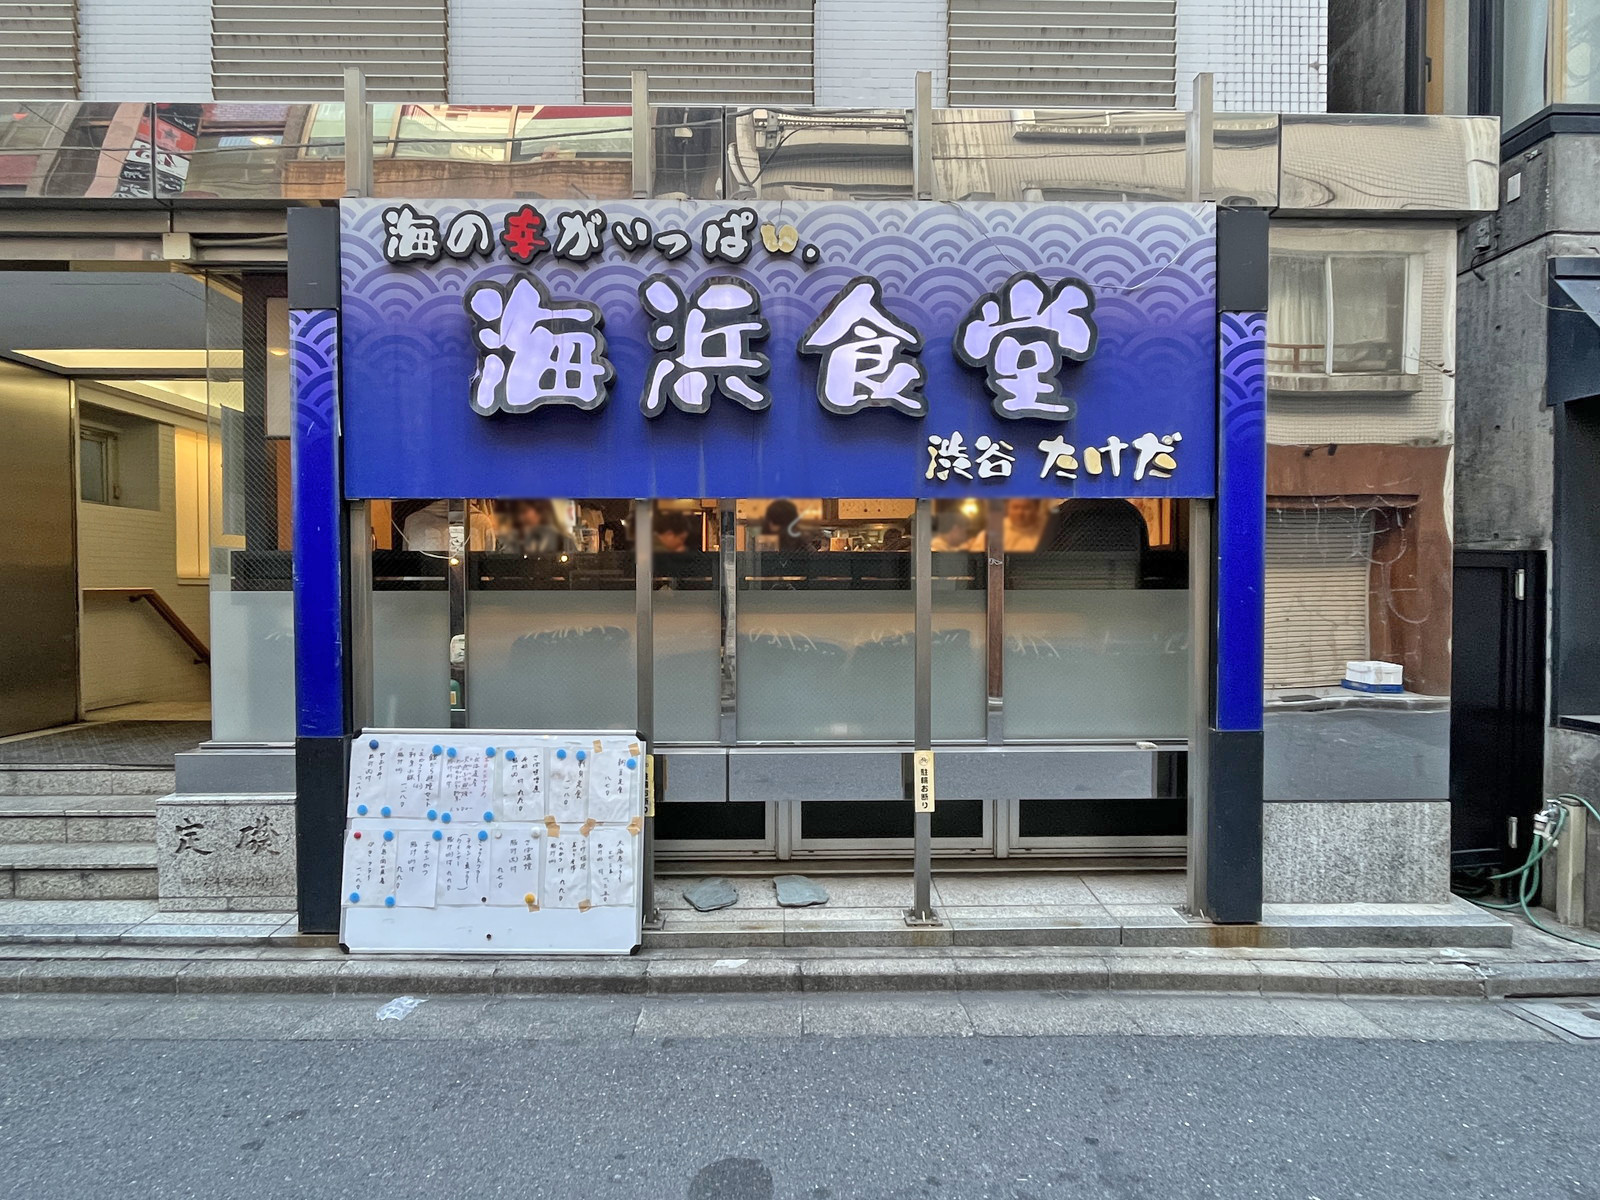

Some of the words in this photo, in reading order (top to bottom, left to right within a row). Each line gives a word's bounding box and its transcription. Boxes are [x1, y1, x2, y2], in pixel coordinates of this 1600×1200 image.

[463, 272, 1096, 420] 海浜食堂
[925, 430, 1016, 482] 渋谷
[1038, 431, 1183, 482] たけだ
[174, 815, 281, 856] 定礎
